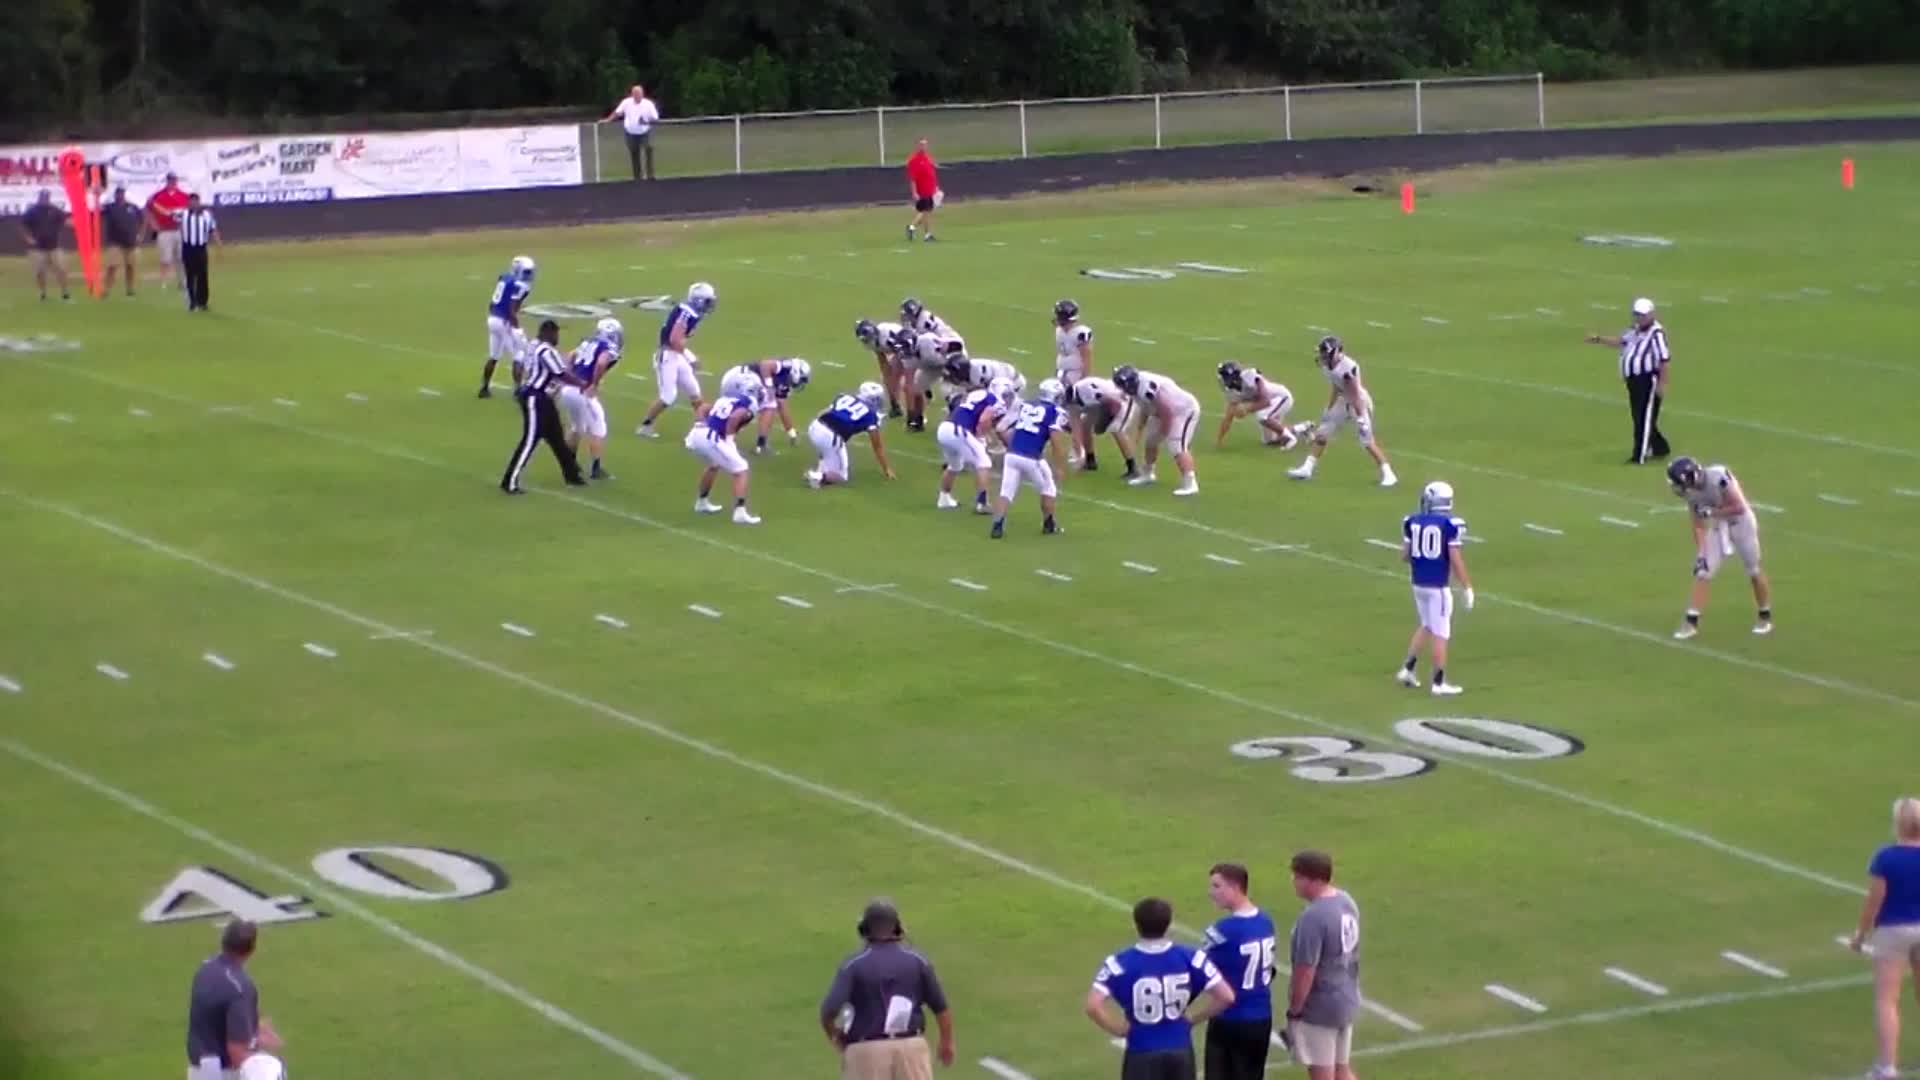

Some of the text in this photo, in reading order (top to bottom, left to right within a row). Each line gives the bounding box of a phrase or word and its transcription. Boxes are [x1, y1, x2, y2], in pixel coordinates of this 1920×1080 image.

[279, 142, 332, 158] GARDEN
[280, 159, 316, 175] MART
[218, 192, 241, 205] GO
[1410, 523, 1442, 560] 10
[1230, 716, 1586, 783] 30
[140, 845, 508, 925] 40
[1239, 937, 1275, 990] 75
[1132, 973, 1191, 1024] 65
